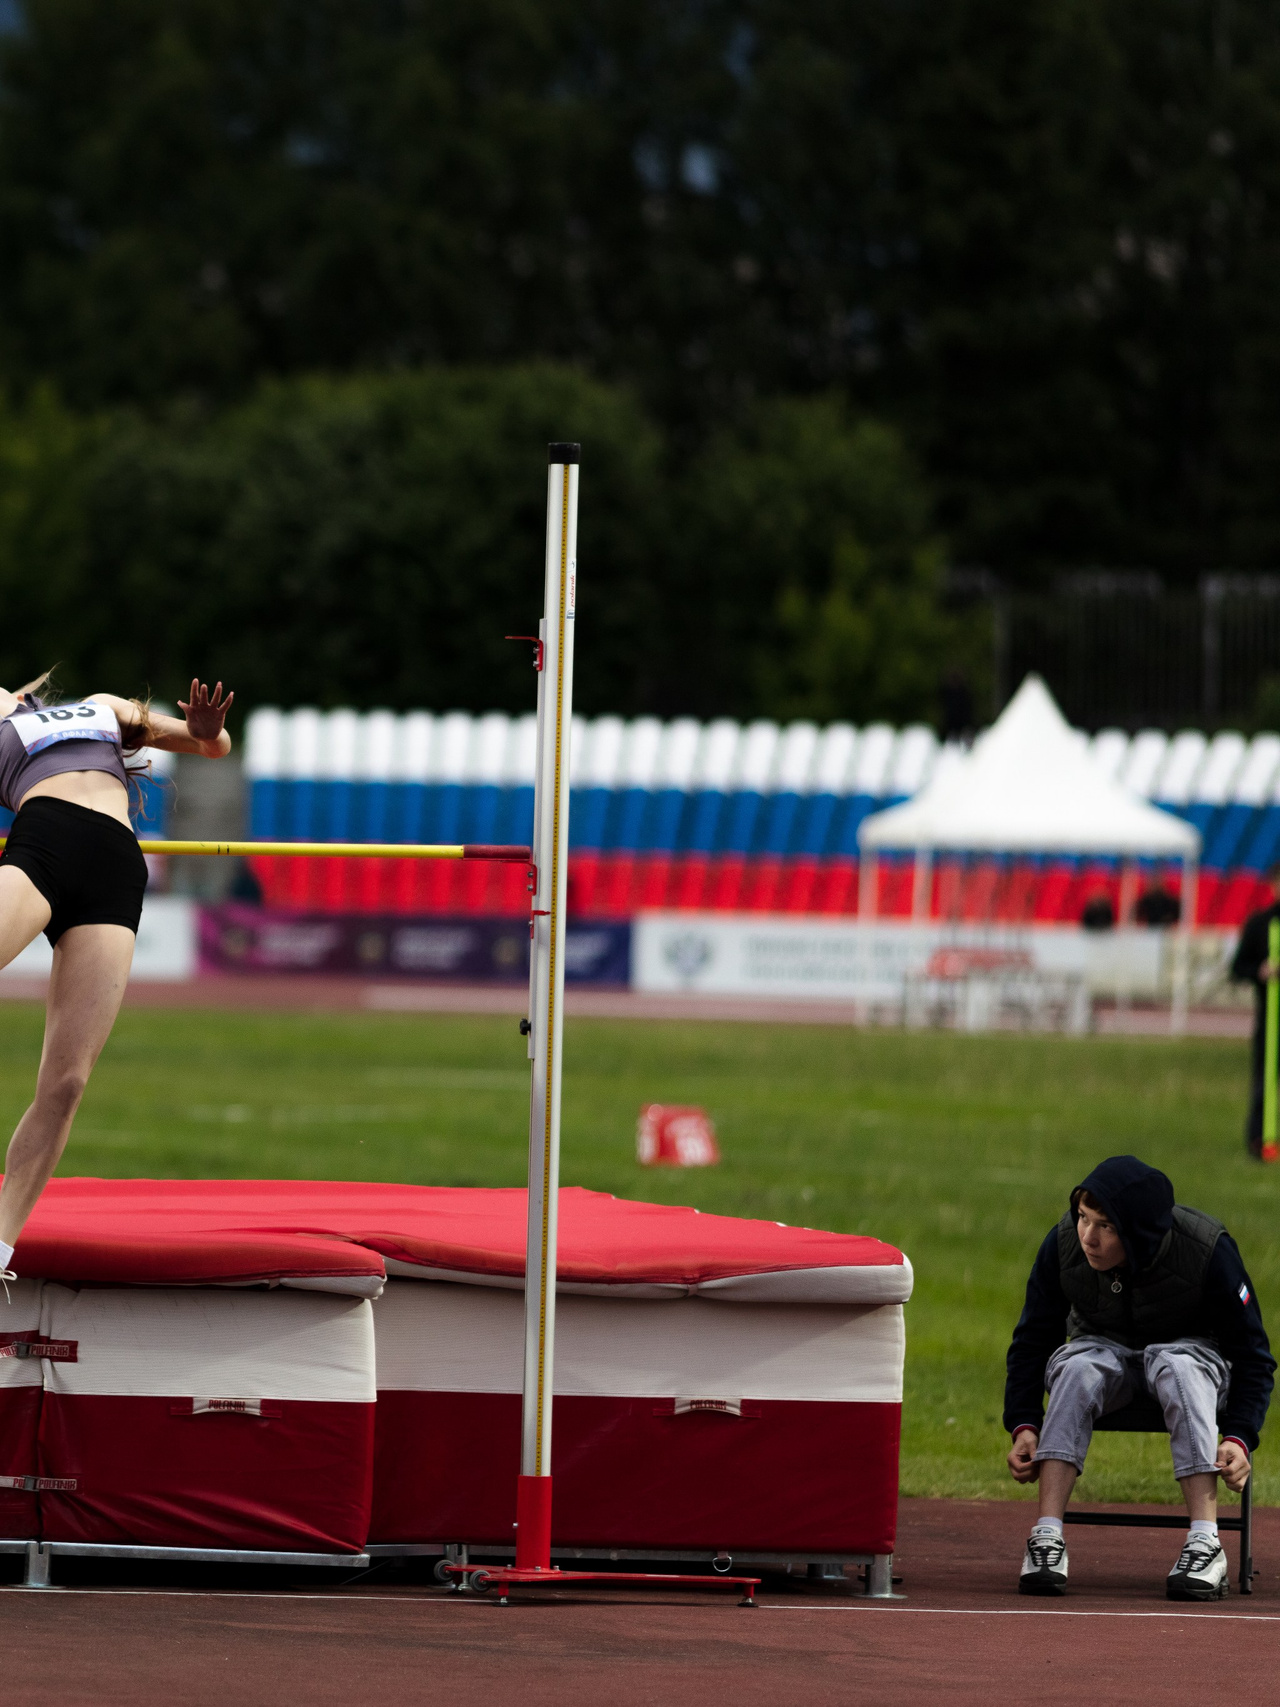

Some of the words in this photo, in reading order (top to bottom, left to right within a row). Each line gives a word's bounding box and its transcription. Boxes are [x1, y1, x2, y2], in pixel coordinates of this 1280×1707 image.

[30, 1344, 69, 1357] POLANIK
[208, 1399, 246, 1412] POLANIK
[38, 1478, 77, 1490] POLANIK
